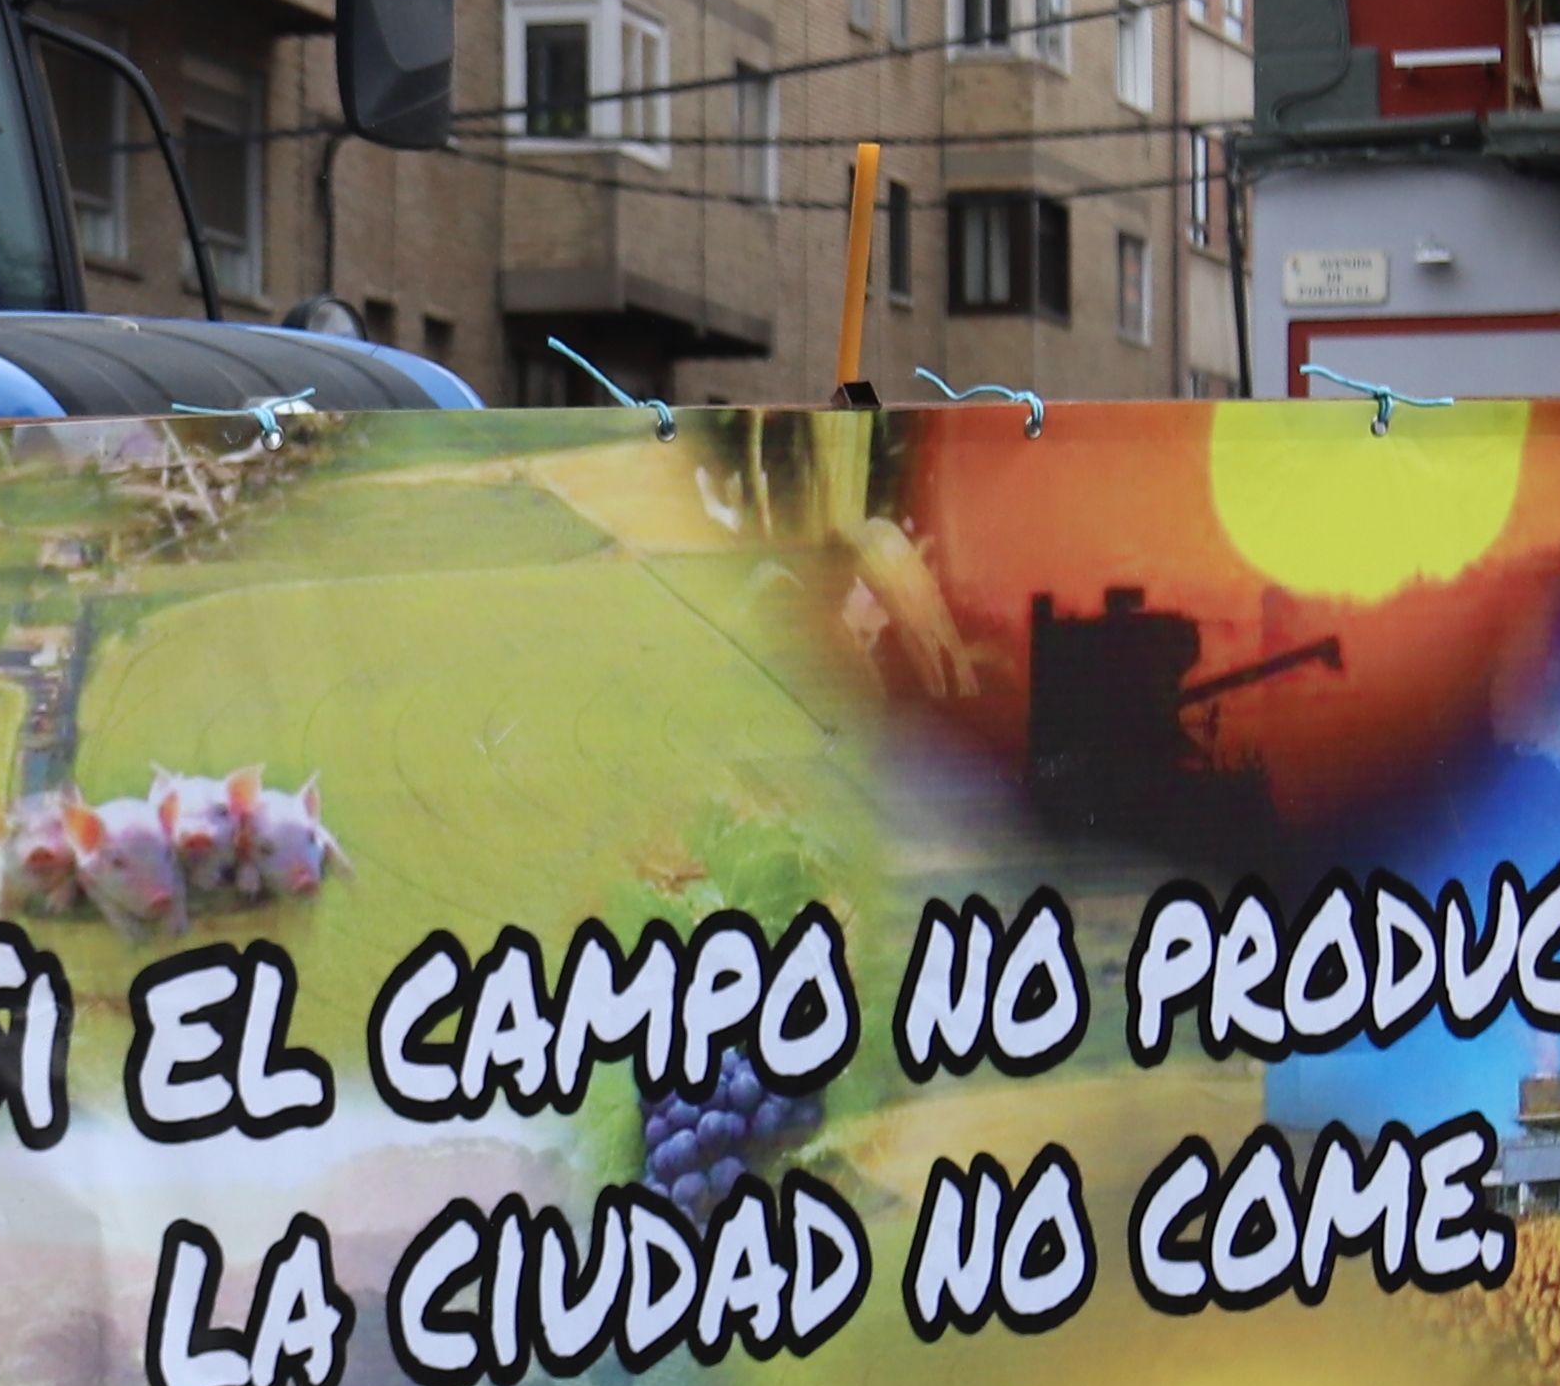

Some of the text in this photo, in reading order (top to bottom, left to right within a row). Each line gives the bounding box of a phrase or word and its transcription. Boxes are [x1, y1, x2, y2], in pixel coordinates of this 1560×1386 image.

[124, 937, 335, 1144] EL
[367, 900, 860, 1123] CAMPO
[893, 885, 1090, 1084] NO
[902, 1141, 1097, 1342] NO
[1129, 1110, 1516, 1315] COME.
